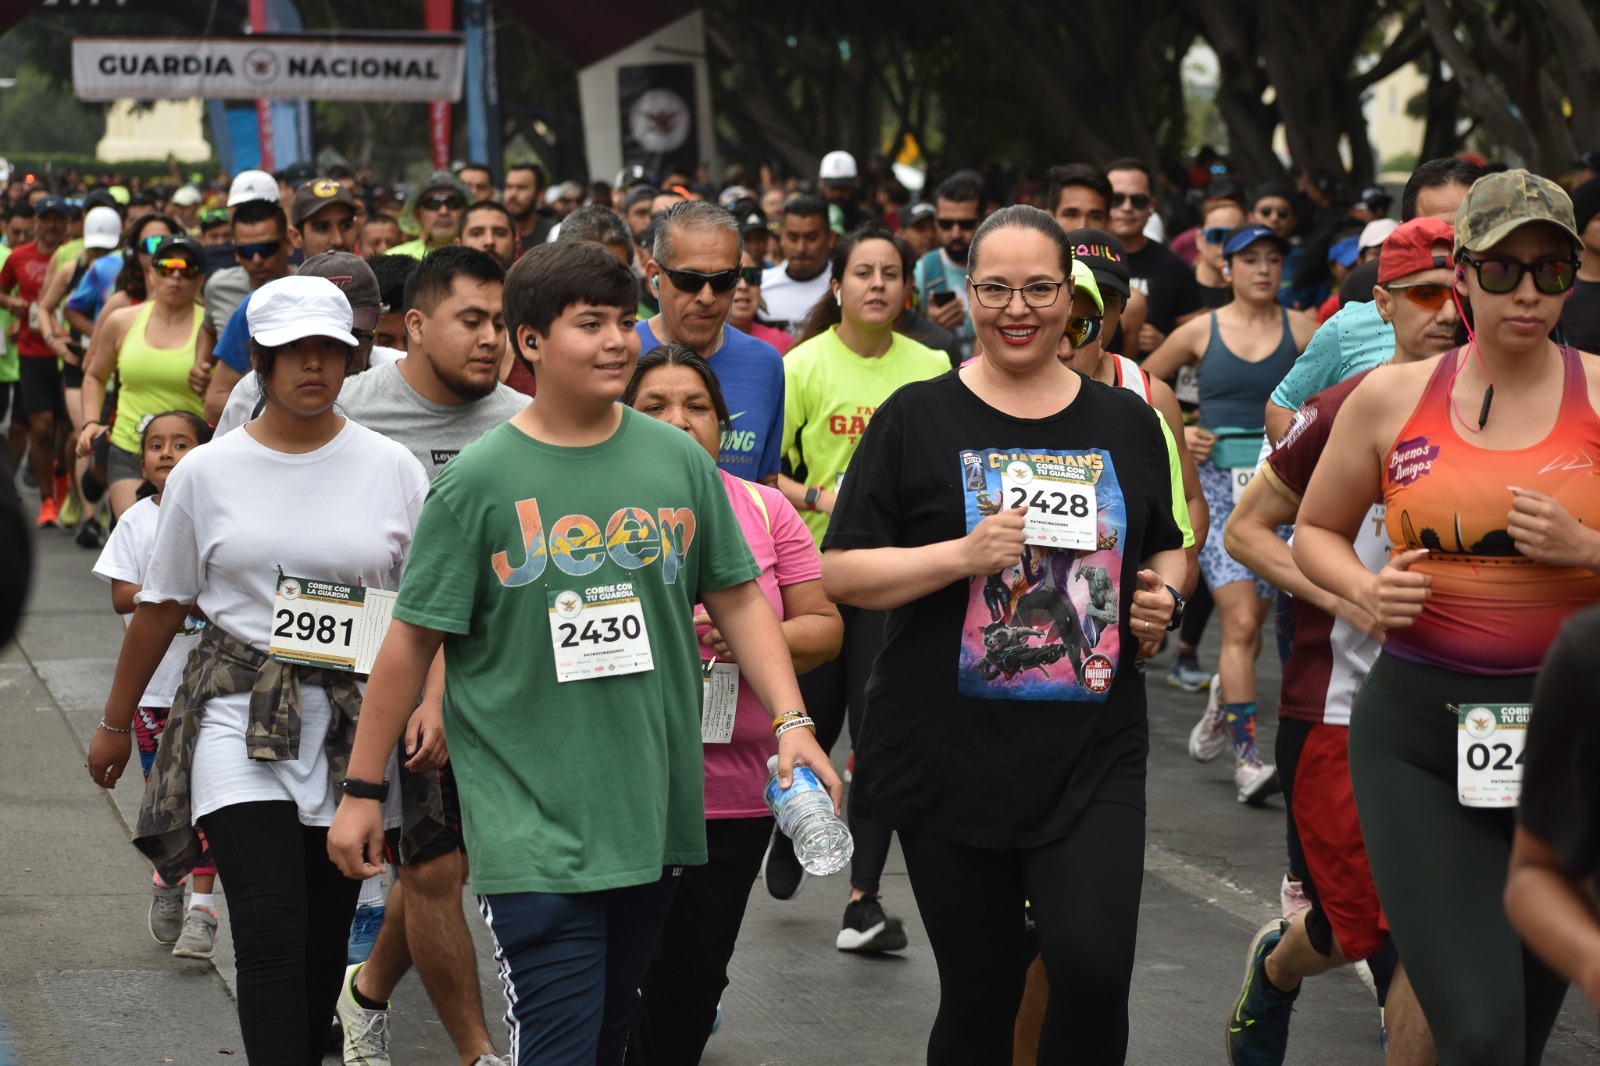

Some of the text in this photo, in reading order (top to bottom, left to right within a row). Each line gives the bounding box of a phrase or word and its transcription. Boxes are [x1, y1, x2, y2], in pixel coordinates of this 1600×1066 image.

[98, 55, 440, 80] GUARDIA NACIONAL
[1389, 445, 1430, 468] Buenos
[1035, 463, 1085, 474] CORRE CON
[1049, 470, 1086, 480] GUARDIA
[1394, 460, 1432, 480] Amigos
[1010, 487, 1089, 518] 2428
[491, 497, 696, 587] Jeep
[308, 582, 351, 594] CORRE CON
[317, 589, 349, 599] GUARDIA
[585, 582, 633, 596] CORRE CON
[586, 590, 634, 602] TU GUARDIA
[273, 609, 354, 647] 2981
[558, 614, 641, 648] 2430
[1085, 669, 1112, 679] INFINITY
[1091, 679, 1105, 687] SAGA
[1501, 715, 1514, 723] TU
